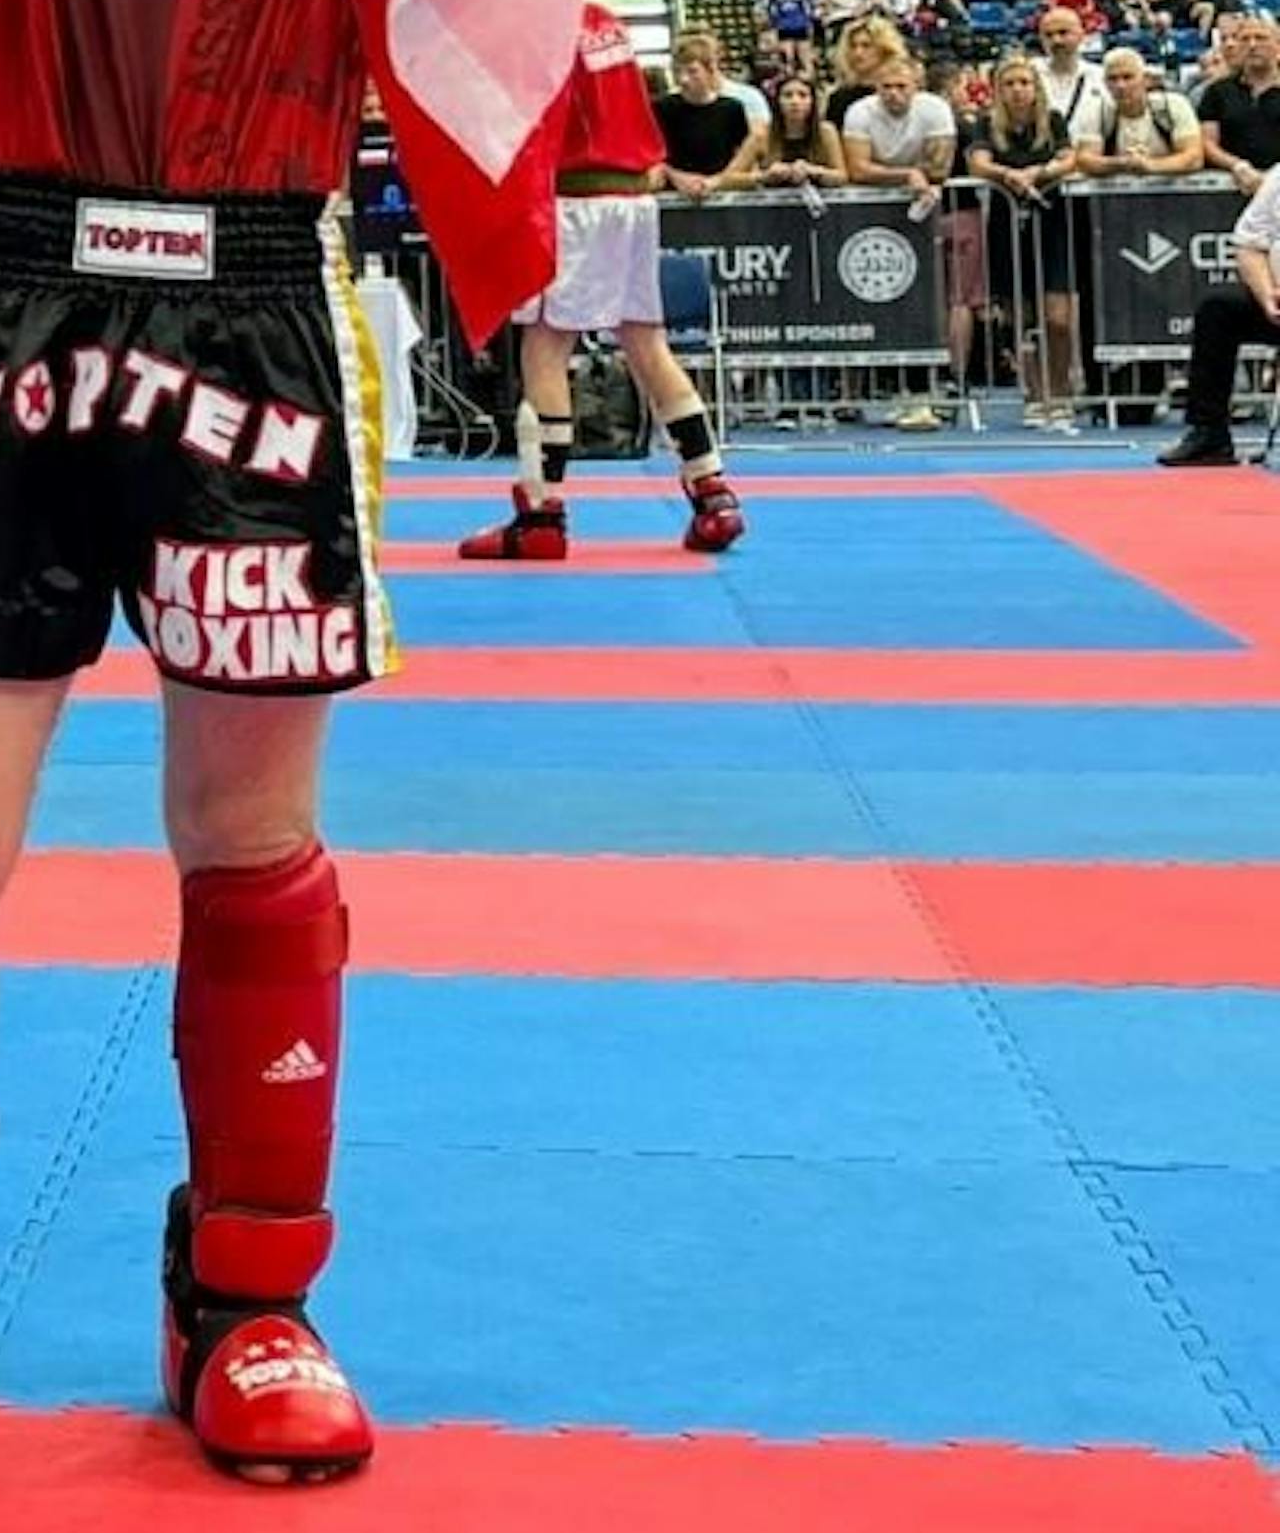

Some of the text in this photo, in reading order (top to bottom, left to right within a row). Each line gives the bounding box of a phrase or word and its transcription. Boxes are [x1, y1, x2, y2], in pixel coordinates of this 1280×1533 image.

[85, 224, 204, 256] TOPTEN
[785, 324, 875, 342] SPONSOR
[154, 539, 312, 616] KICK
